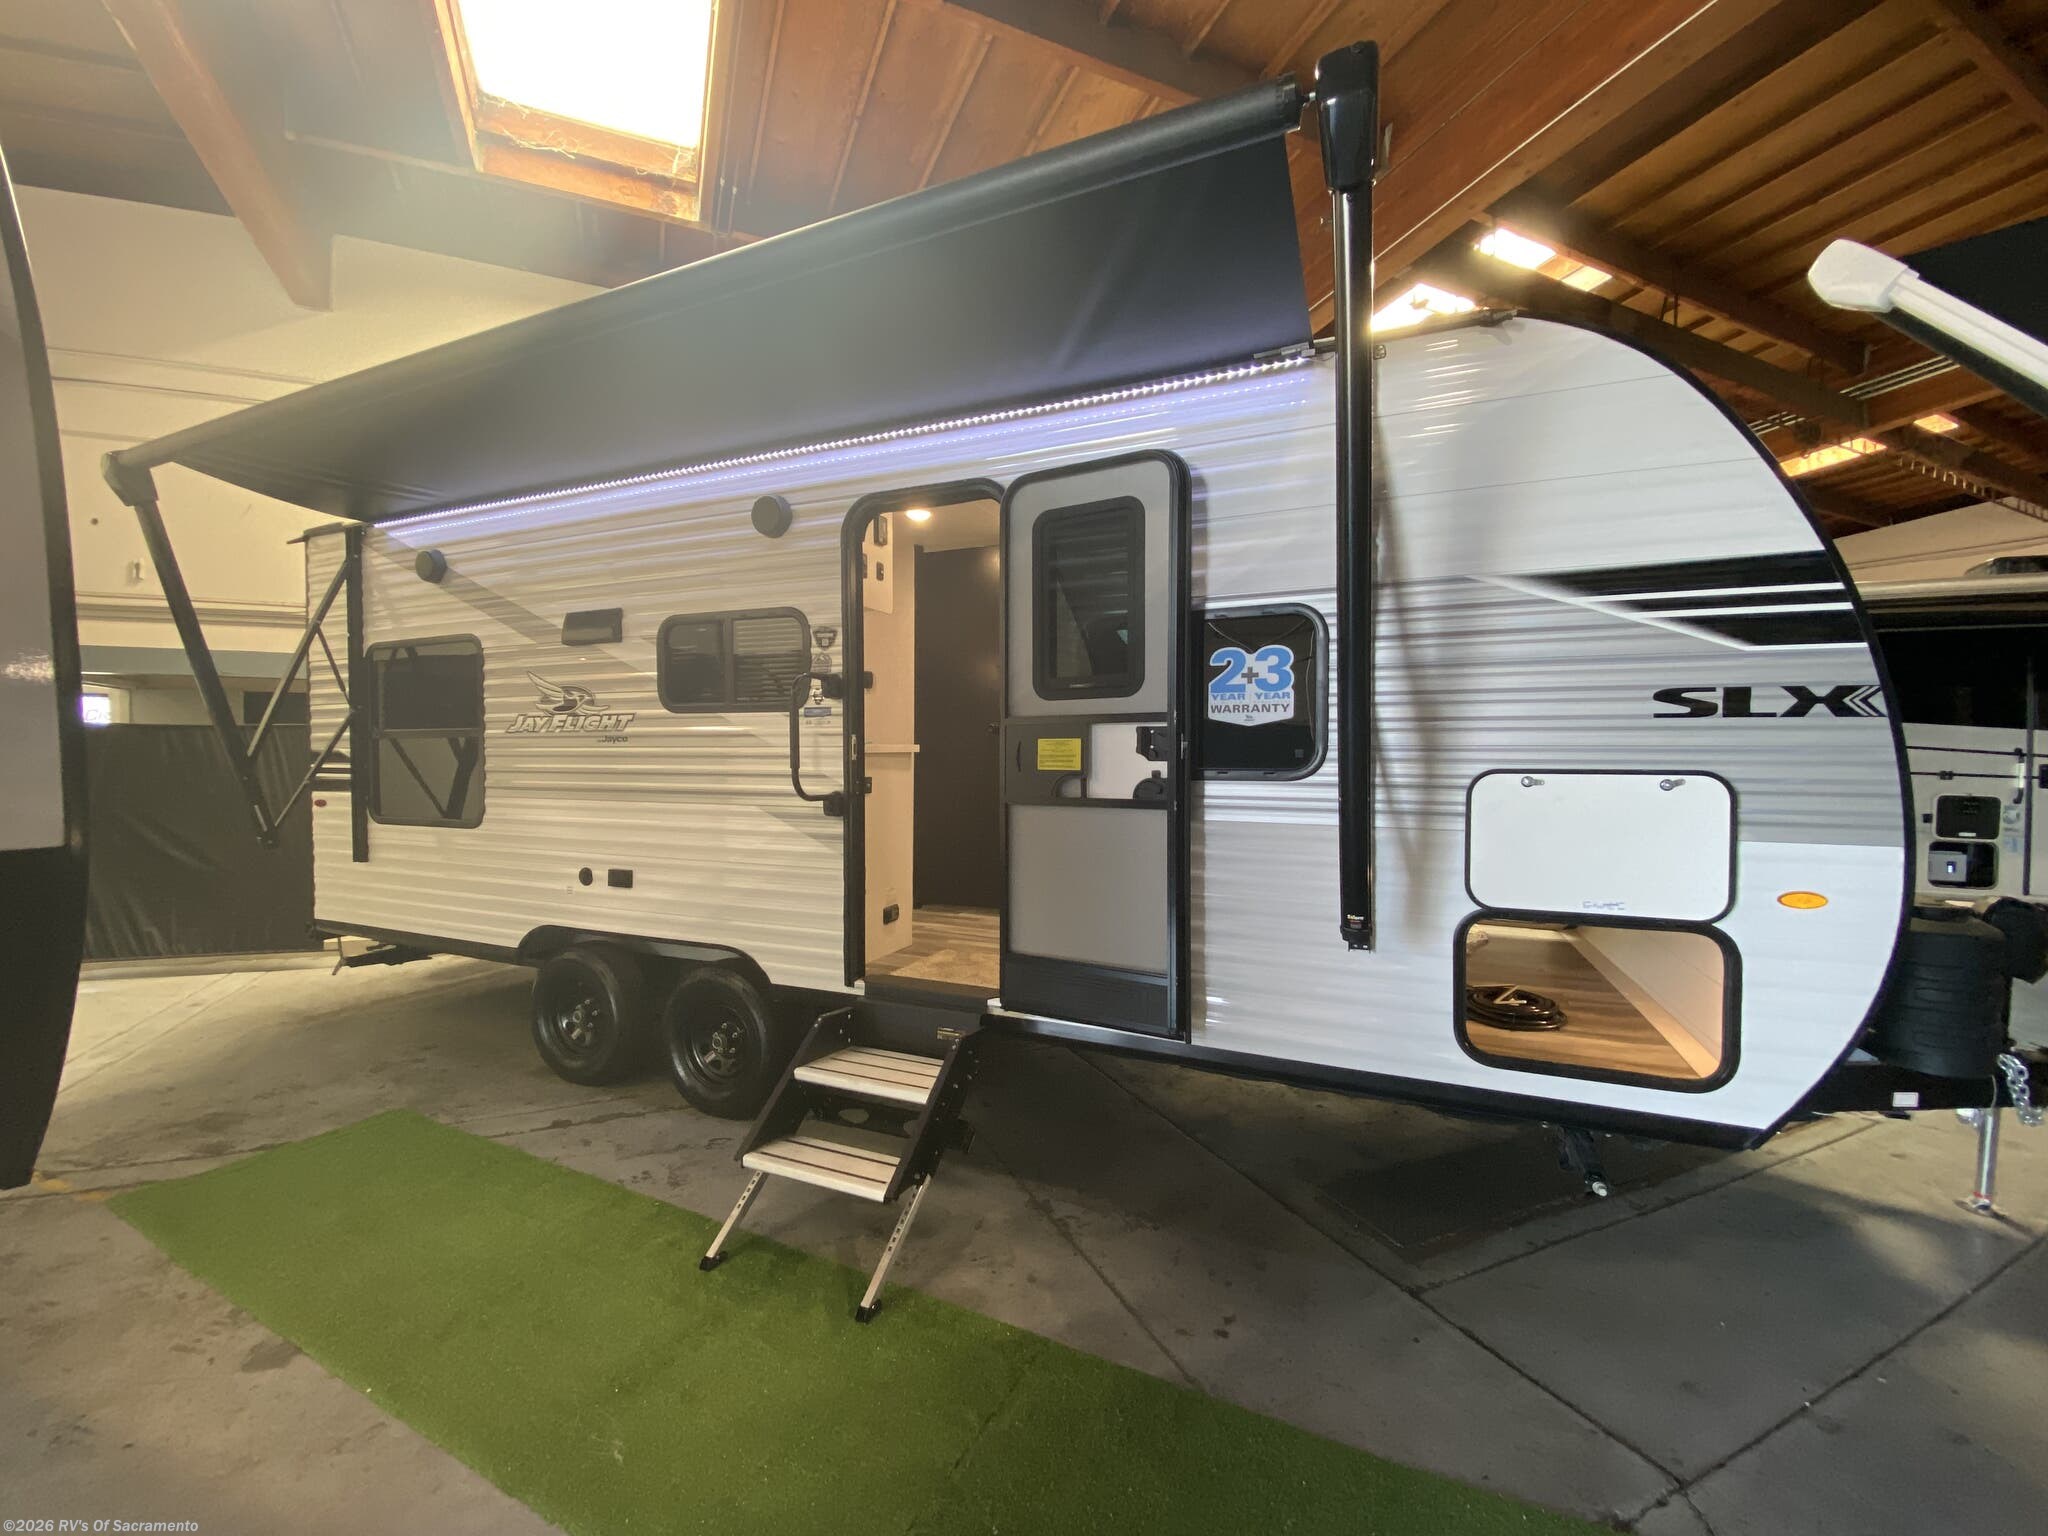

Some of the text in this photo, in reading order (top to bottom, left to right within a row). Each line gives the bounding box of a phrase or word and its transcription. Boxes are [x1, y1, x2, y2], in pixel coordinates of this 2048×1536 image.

[1211, 691, 1291, 701] YEAR YEAR
[1652, 685, 1872, 718] SLX
[1210, 703, 1290, 714] WARRANTY
[506, 713, 636, 734] JAY FLIGHT
